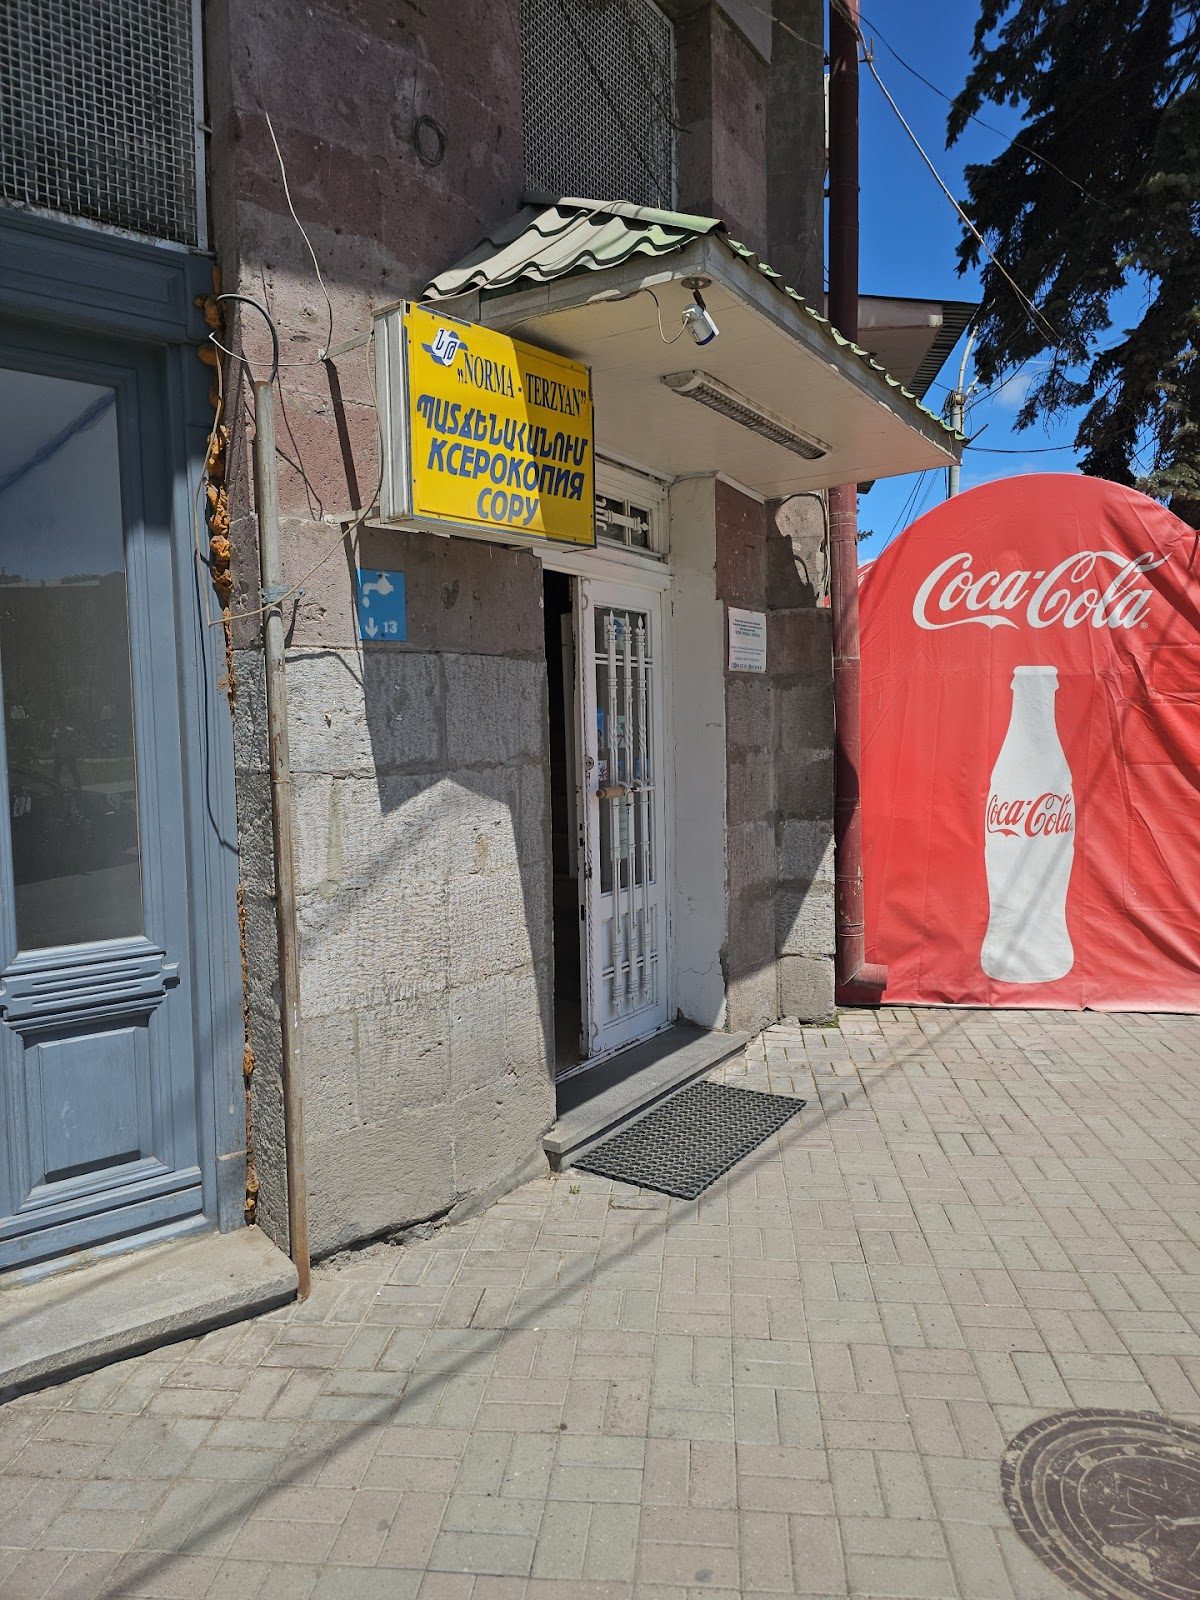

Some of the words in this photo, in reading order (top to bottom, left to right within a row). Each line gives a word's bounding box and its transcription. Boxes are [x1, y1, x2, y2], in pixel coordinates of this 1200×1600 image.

[416, 394, 588, 466] ՊԱՏՃԵՆԱՀԱՆՈՒՄ
[427, 437, 585, 501] КСЕРОКОПИЯ
[477, 488, 539, 526] COPY
[912, 550, 1173, 630] Coca-Cola
[383, 620, 398, 634] 13
[987, 793, 1072, 838] Coca-Cola
